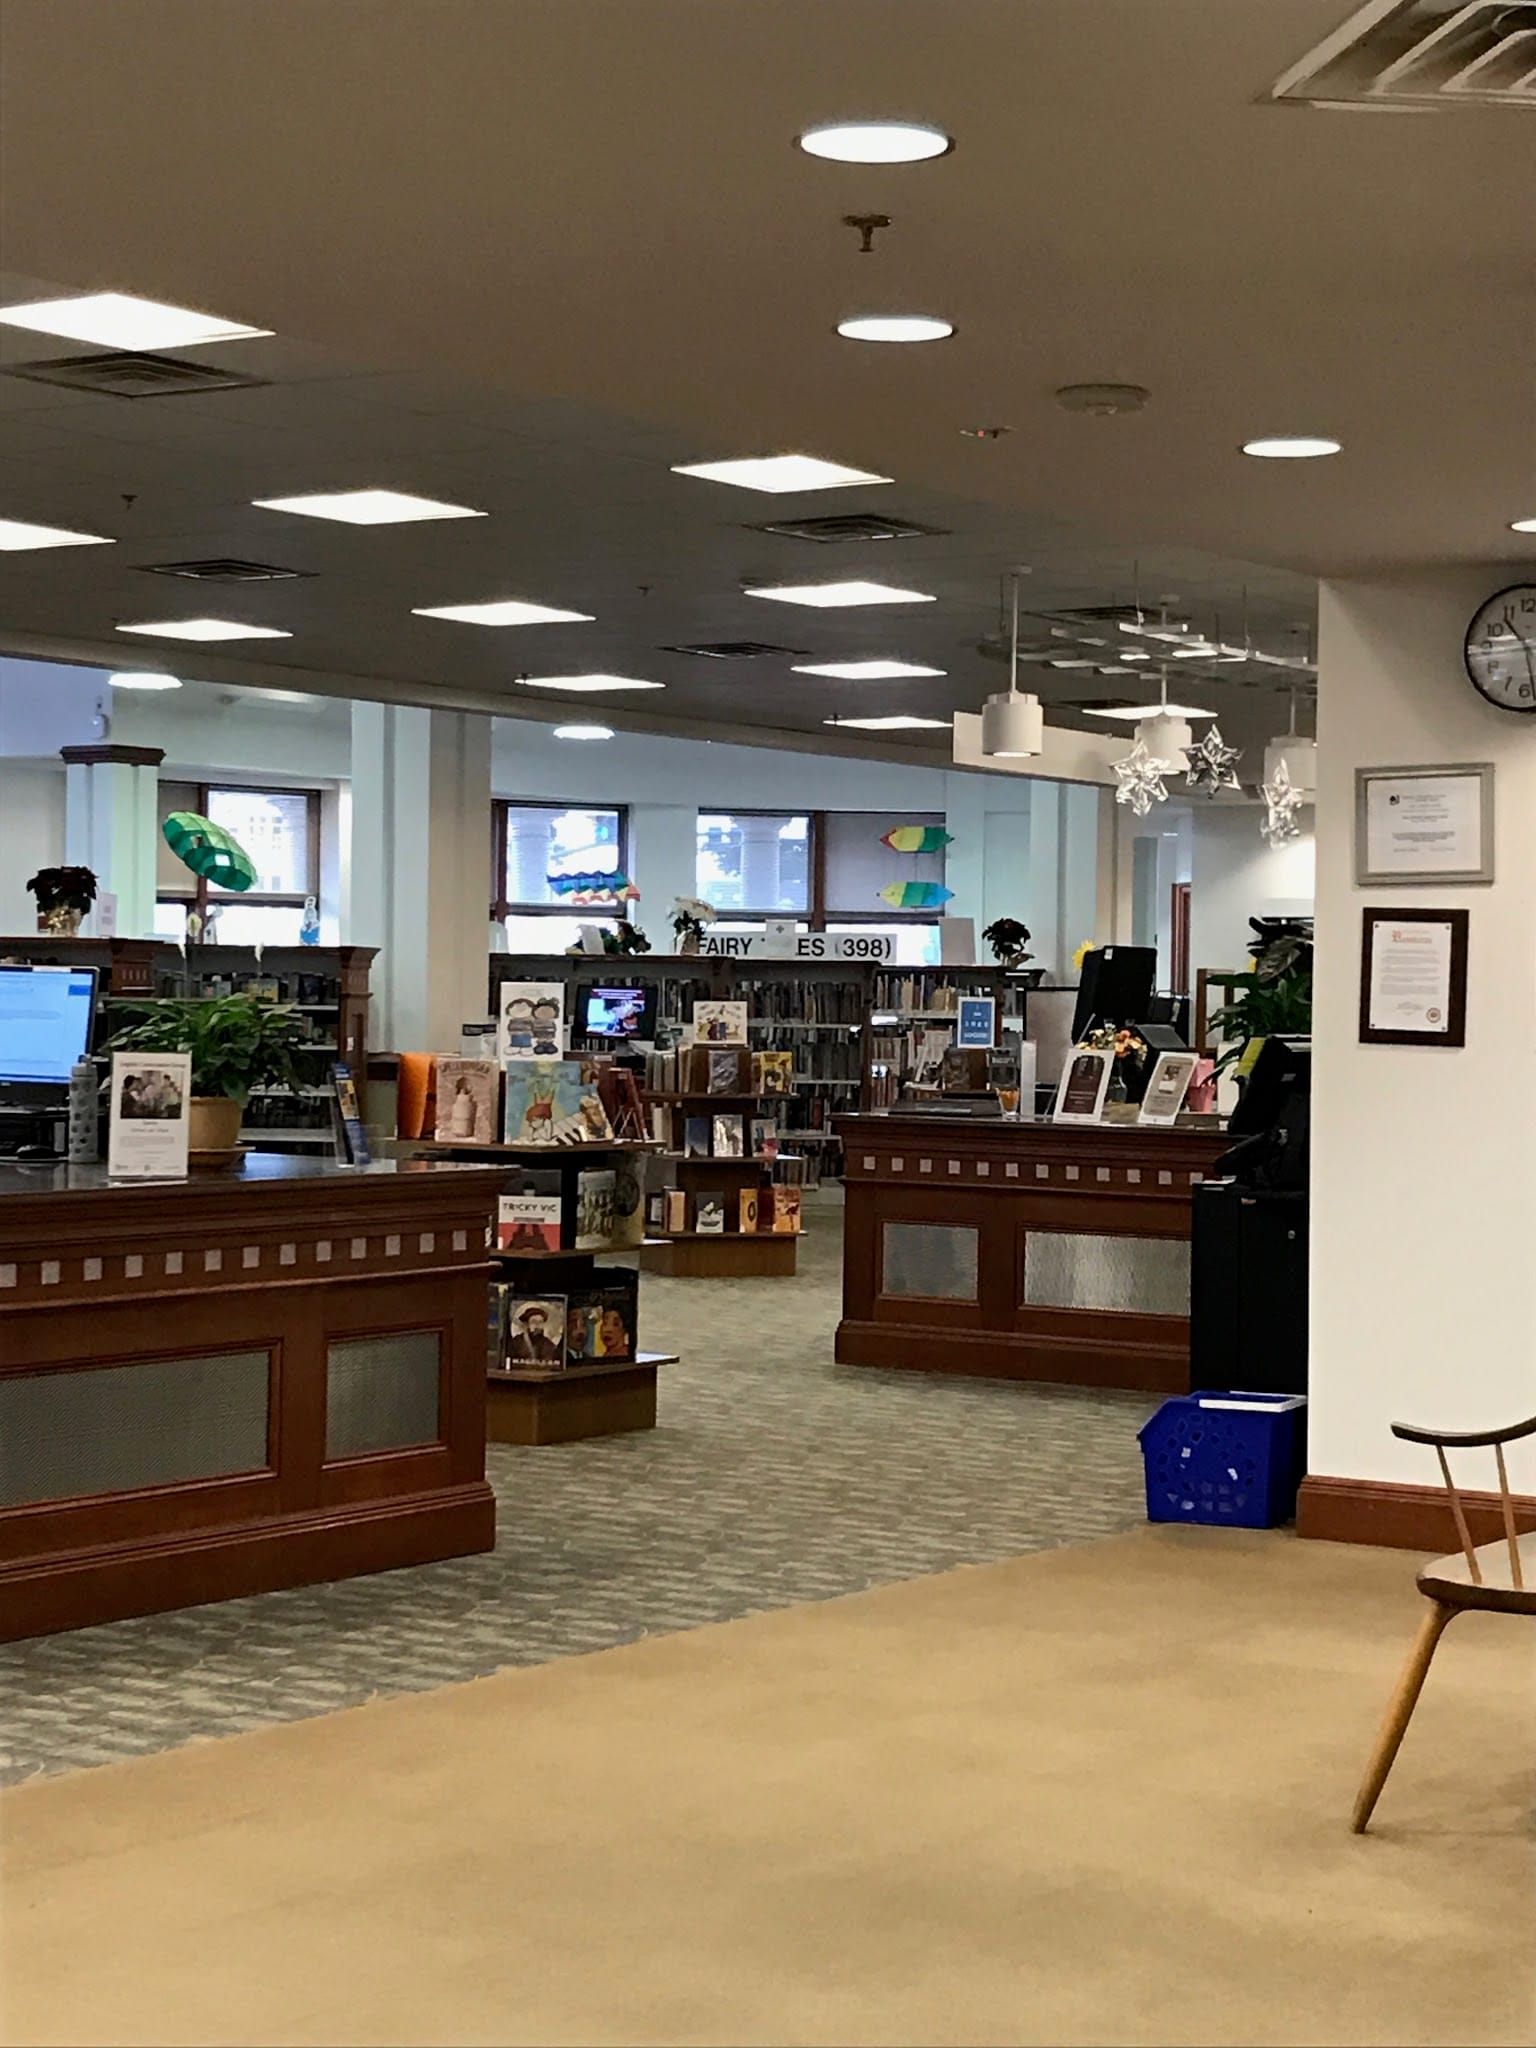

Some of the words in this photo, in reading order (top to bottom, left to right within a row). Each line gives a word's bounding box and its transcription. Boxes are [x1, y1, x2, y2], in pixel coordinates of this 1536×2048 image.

[1521, 598, 1536, 613] 12
[1487, 623, 1504, 637] 10
[1518, 683, 1531, 698] 6
[697, 937, 752, 956] FAIRY
[503, 1202, 538, 1212] TRICKY
[540, 1203, 557, 1213] VIC
